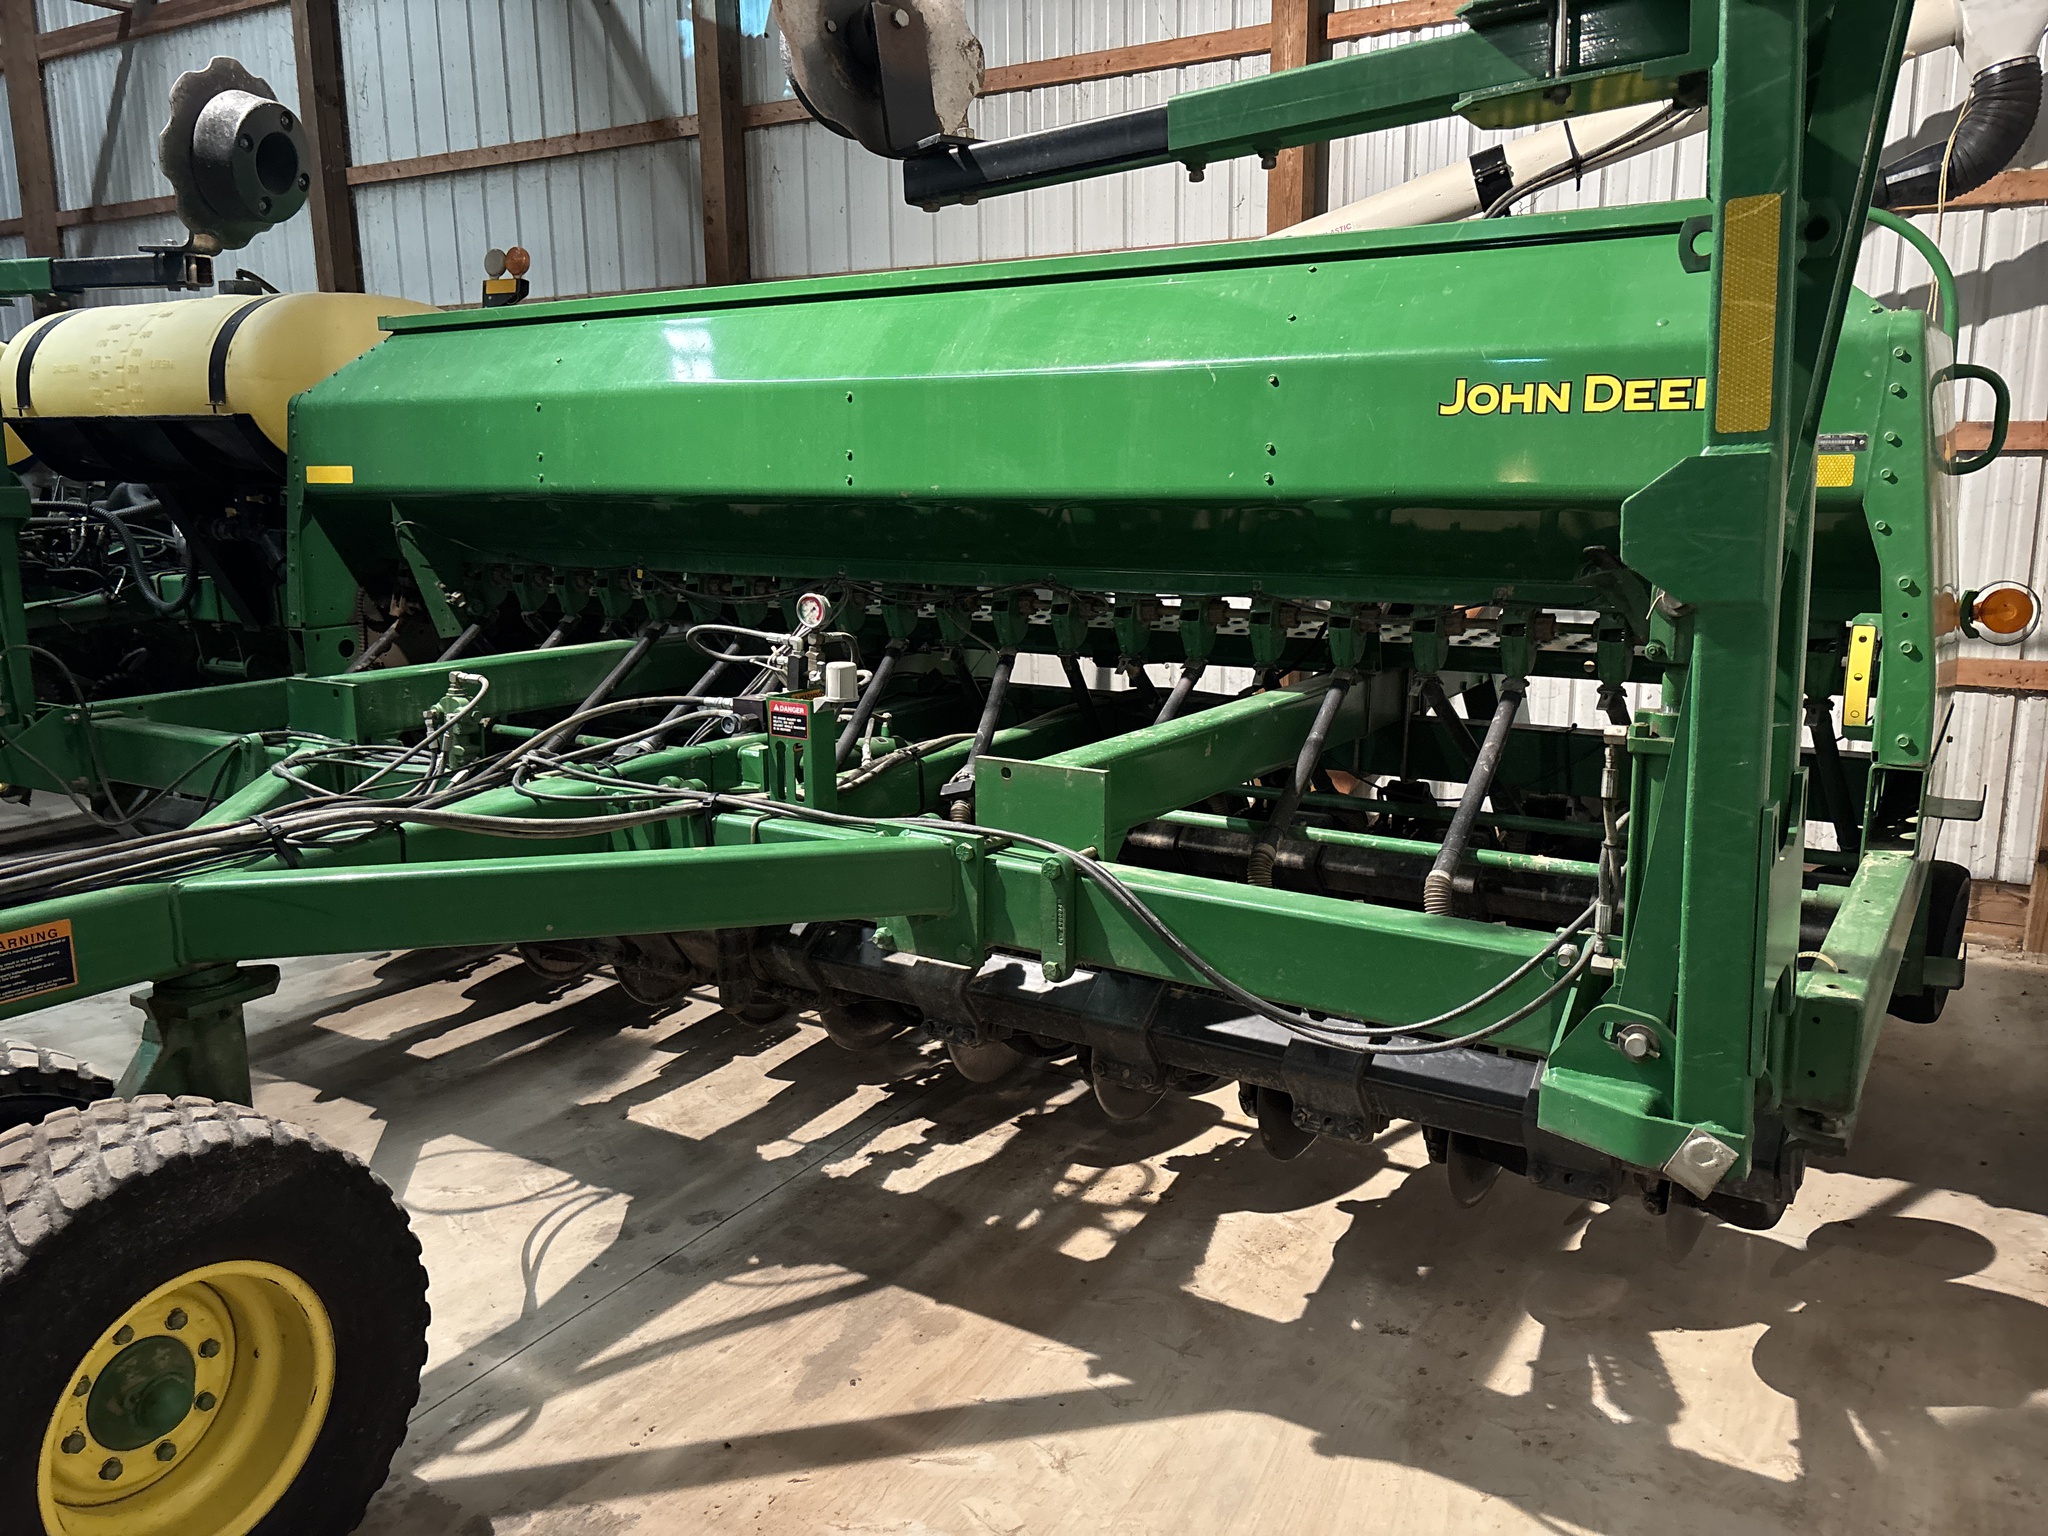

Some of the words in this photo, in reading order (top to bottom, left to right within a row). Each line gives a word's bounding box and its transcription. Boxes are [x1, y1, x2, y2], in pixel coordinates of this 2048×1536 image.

[1323, 222, 1352, 235] ASTIC
[1438, 377, 1572, 416] JOHN
[779, 705, 805, 714] DANGER
